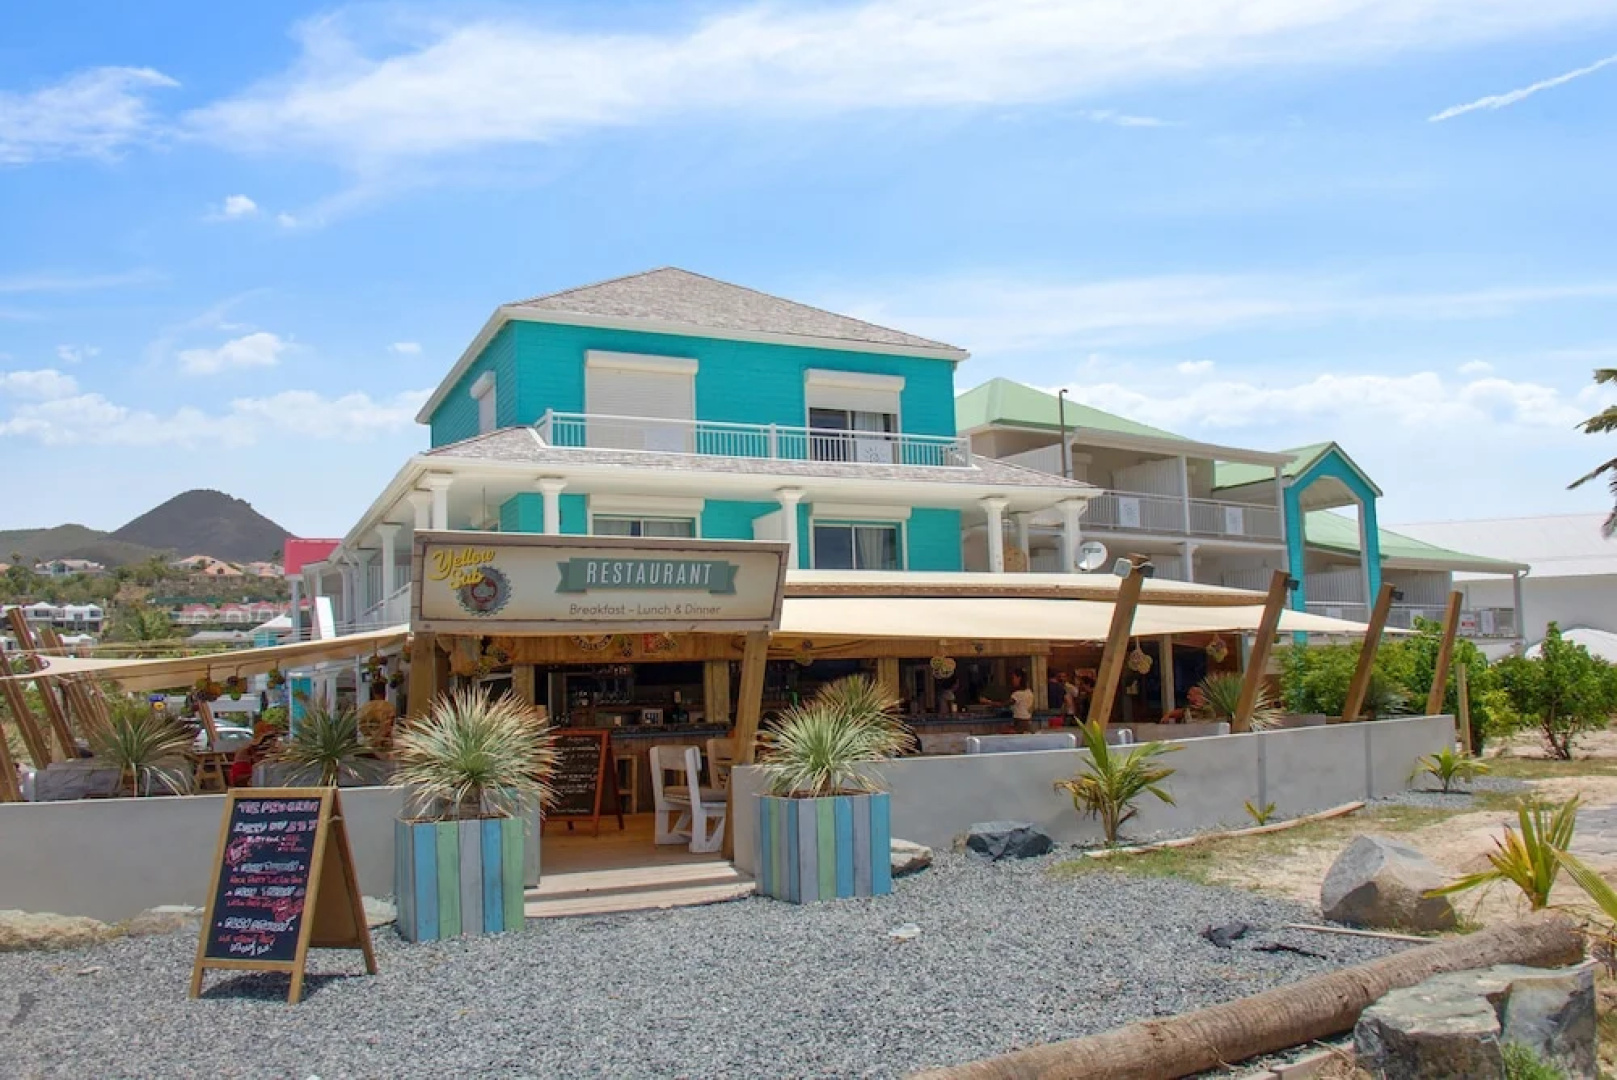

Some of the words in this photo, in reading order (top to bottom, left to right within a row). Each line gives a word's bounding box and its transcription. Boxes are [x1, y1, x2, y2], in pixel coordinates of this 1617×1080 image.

[427, 547, 495, 580] Yellow
[586, 561, 712, 585] RESTAURANT
[447, 567, 485, 590] Sub
[569, 603, 625, 615] Breakfast
[637, 603, 672, 615] Lunch
[674, 604, 682, 615] &
[685, 603, 721, 615] Dinner
